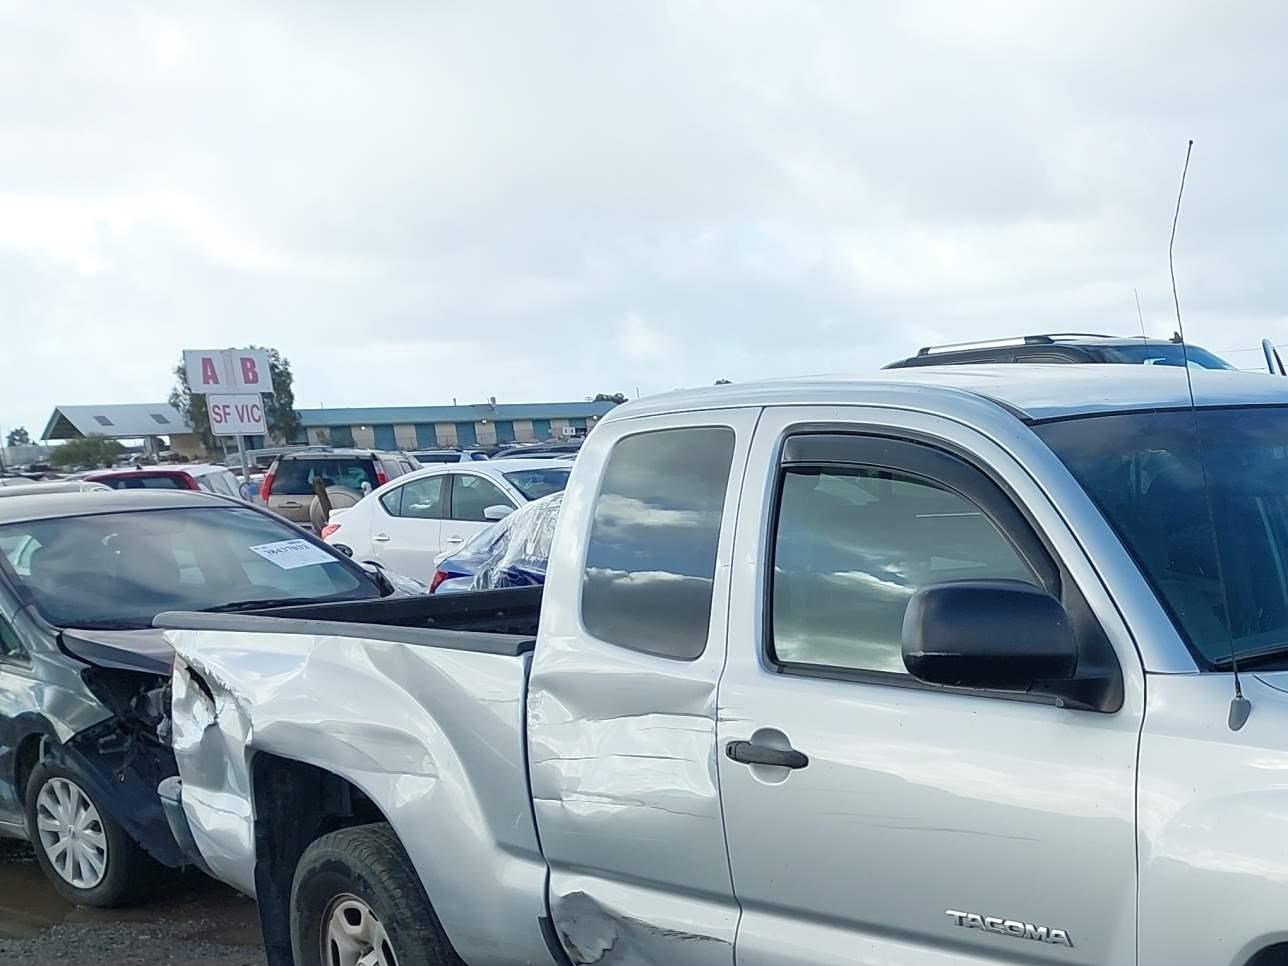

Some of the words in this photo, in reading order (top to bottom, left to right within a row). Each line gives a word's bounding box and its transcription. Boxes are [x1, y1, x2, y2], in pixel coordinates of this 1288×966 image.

[201, 357, 220, 385] A
[239, 357, 260, 385] B
[212, 404, 231, 424] SF
[234, 403, 262, 423] VIC
[944, 909, 1074, 947] TACOMA
